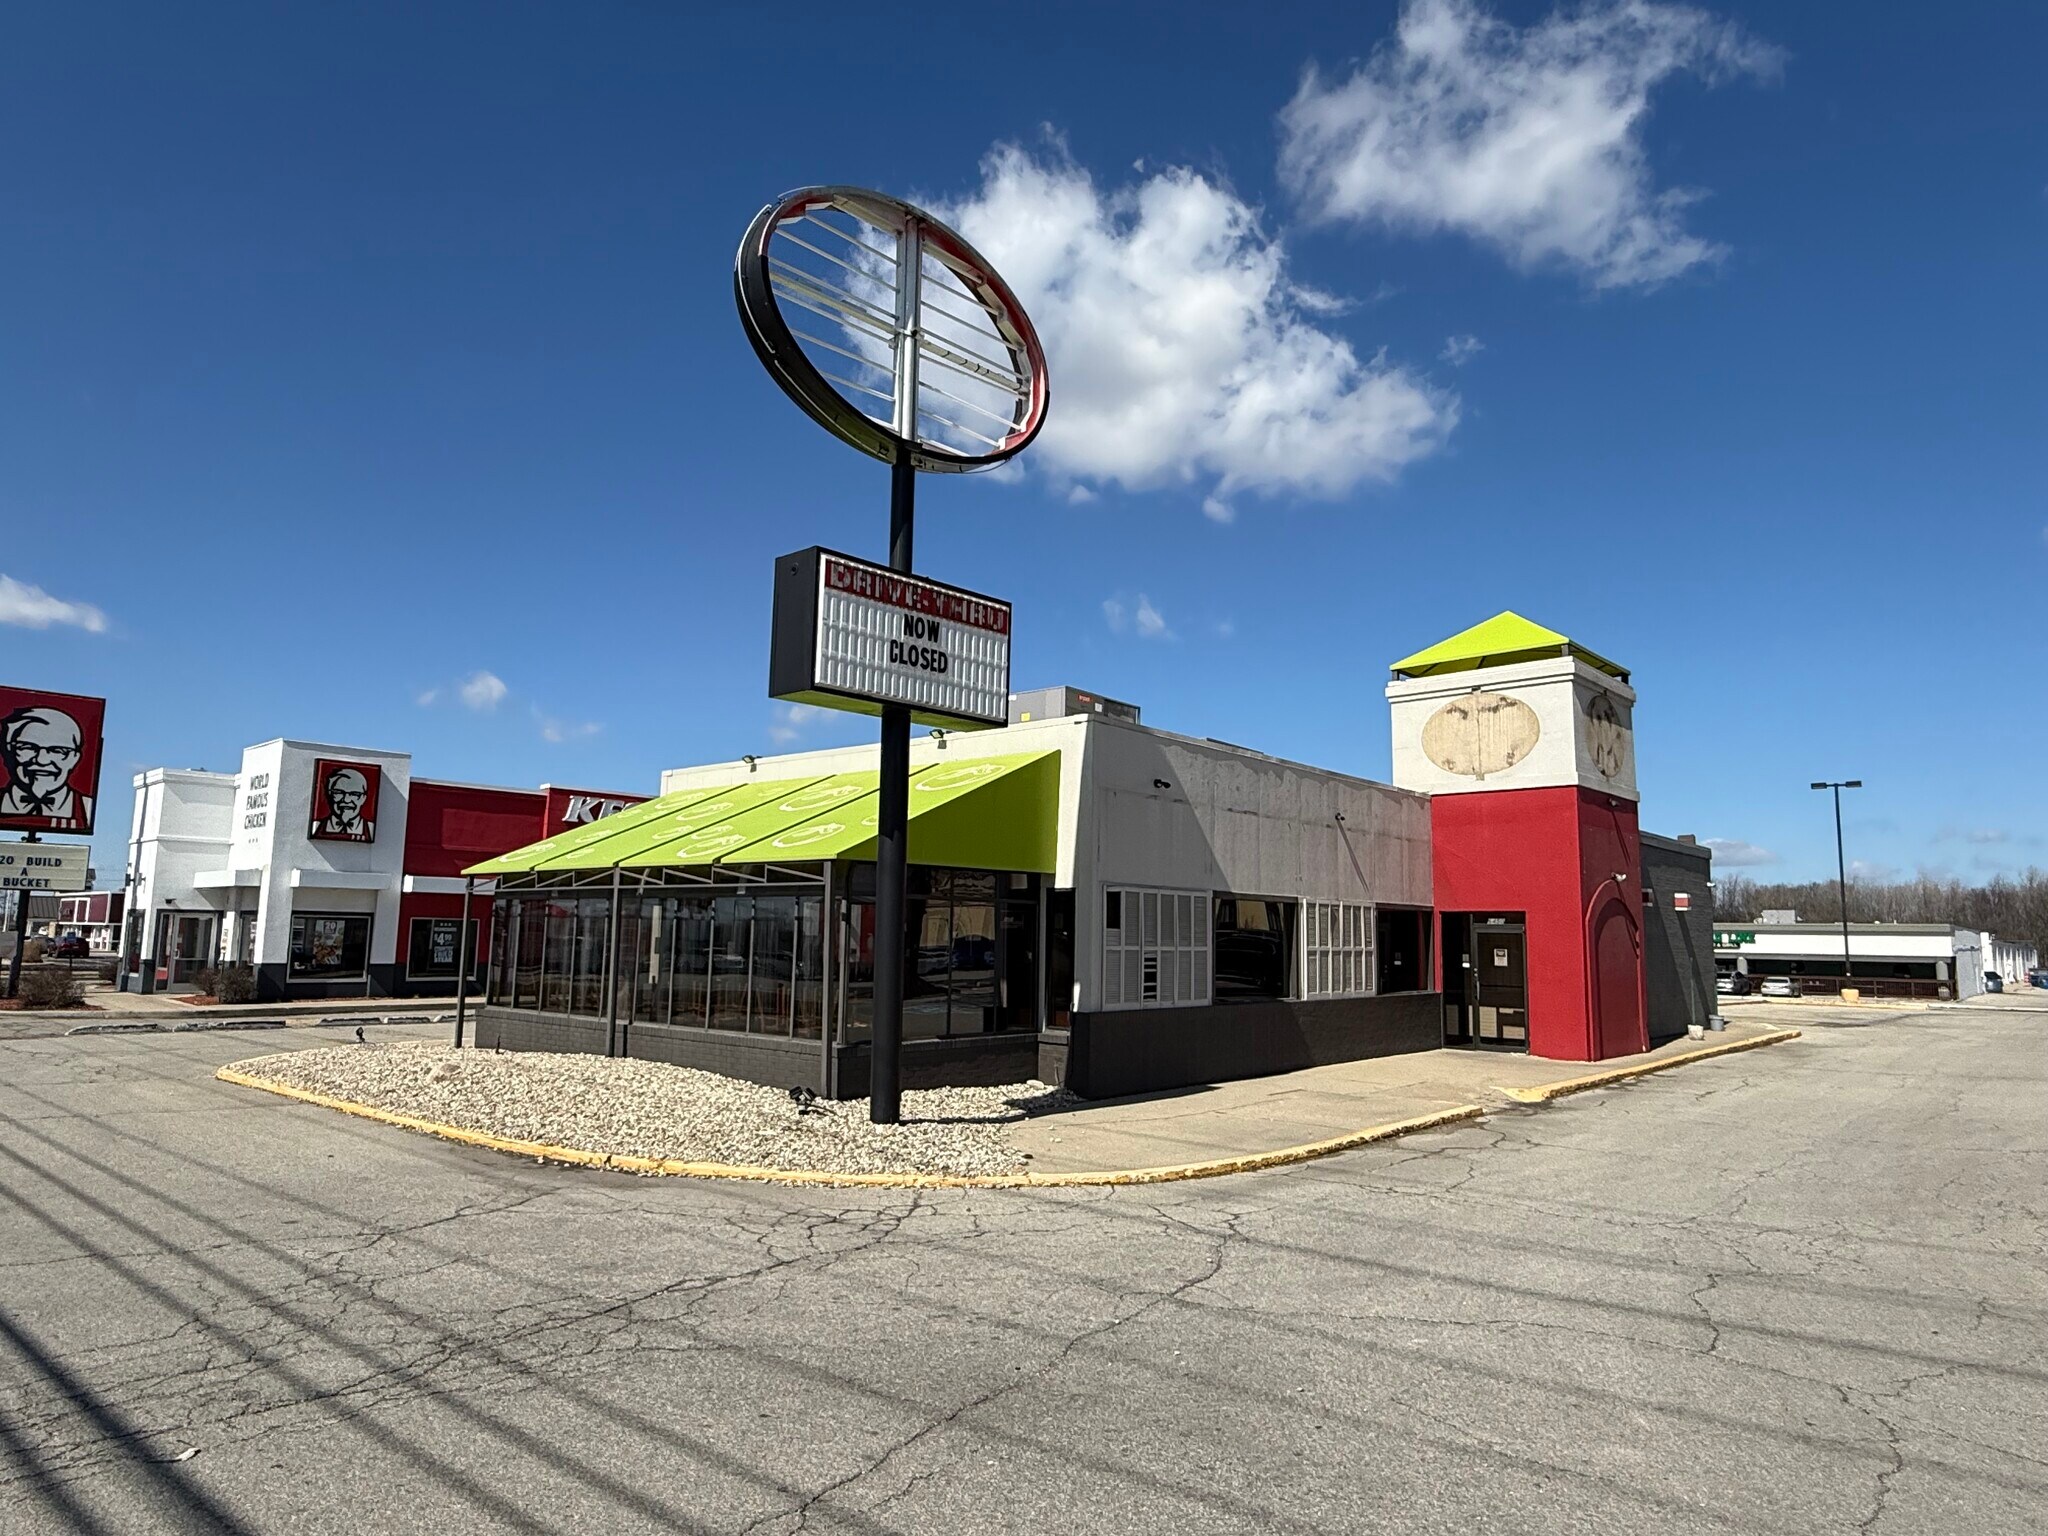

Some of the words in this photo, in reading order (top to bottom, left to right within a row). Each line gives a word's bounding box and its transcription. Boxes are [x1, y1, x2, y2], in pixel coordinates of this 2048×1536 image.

[904, 613, 940, 643] NOW
[889, 639, 948, 674] CLOSED
[250, 773, 270, 791] WORLD
[246, 792, 269, 811] FAMOUS
[562, 795, 641, 823] KF
[244, 812, 267, 830] CHICKEN
[26, 857, 62, 867] BUILD
[20, 867, 28, 876] A
[3, 877, 50, 888] BUCKET
